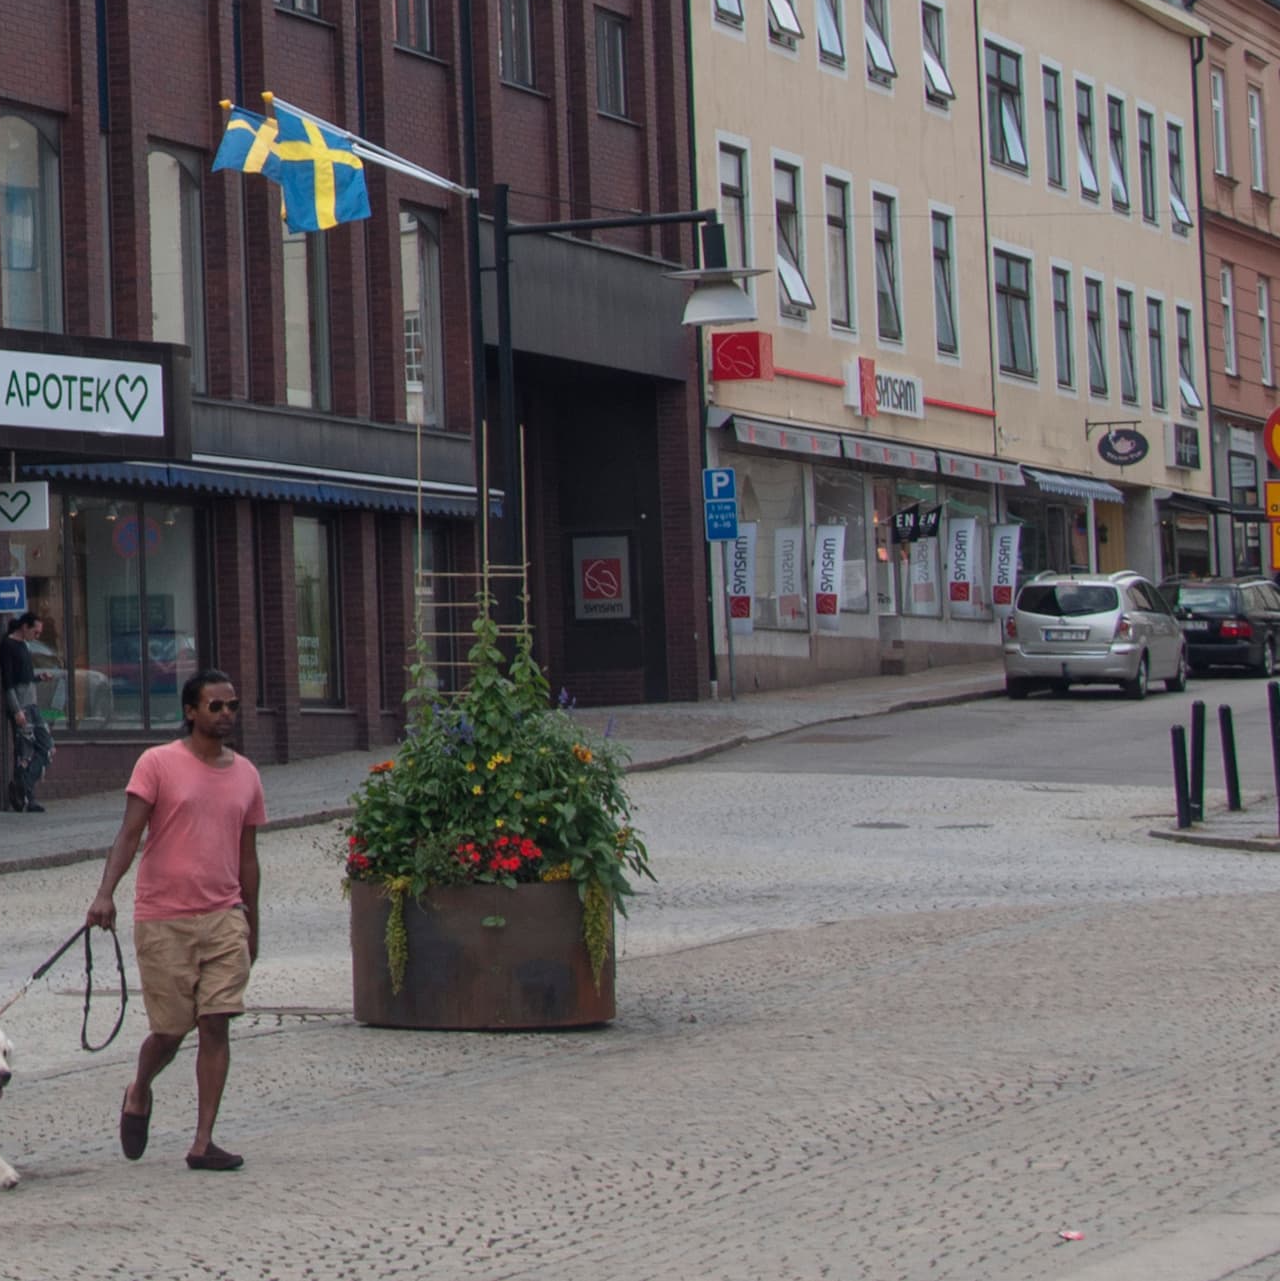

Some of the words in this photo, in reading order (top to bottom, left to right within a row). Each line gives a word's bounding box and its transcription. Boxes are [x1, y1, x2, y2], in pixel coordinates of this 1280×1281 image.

[4, 369, 111, 414] APOTEK
[875, 374, 917, 413] SYNSAM
[711, 472, 730, 498] P
[733, 535, 748, 594] SYNSAM
[820, 537, 836, 593] SYNSAM
[953, 529, 968, 581] SYNSAM
[997, 535, 1012, 585] SYNSAM
